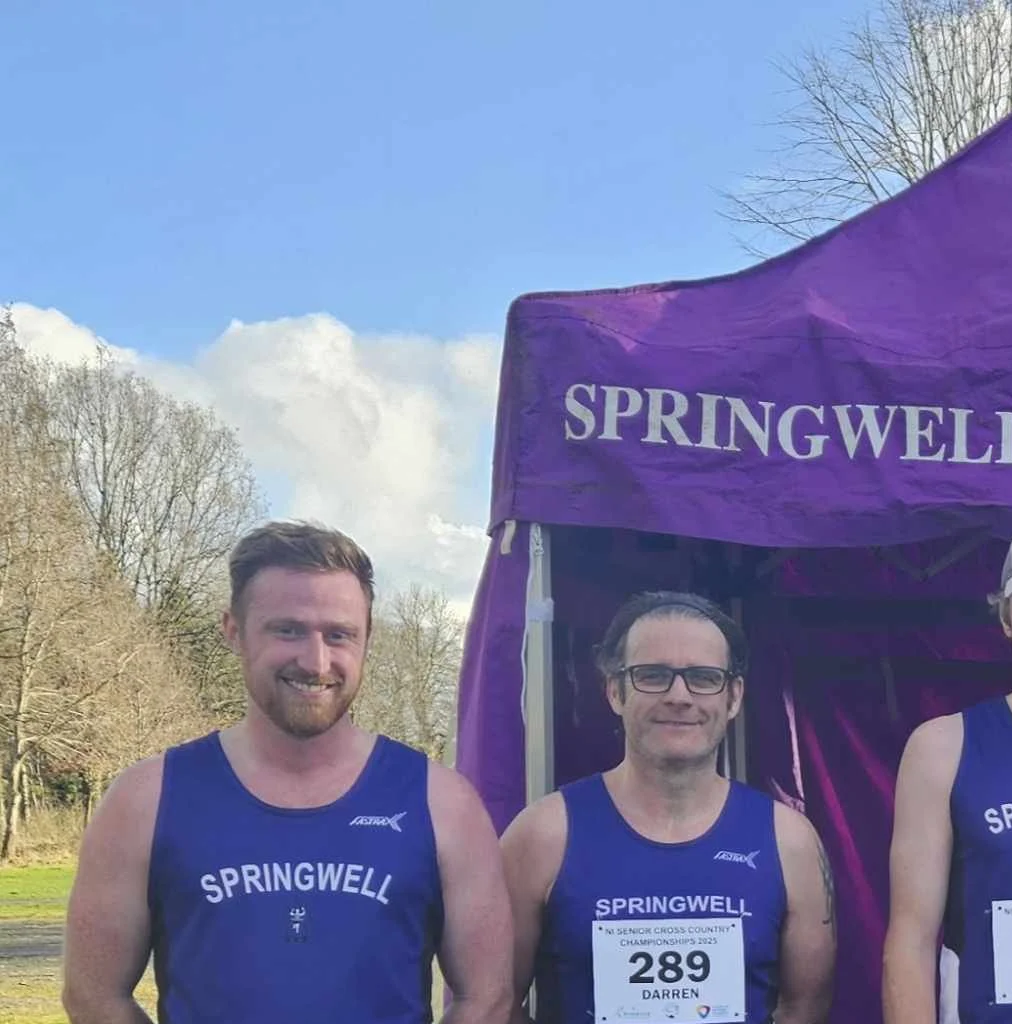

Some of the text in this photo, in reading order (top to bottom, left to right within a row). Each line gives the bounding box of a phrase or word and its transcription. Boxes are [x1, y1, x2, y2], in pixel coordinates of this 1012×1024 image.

[200, 862, 392, 904] SPRINGWELL
[595, 895, 752, 916] SPRINGWELL
[620, 937, 718, 946] CHAMPIONSHIPS 2025
[629, 950, 710, 984] 289
[642, 988, 700, 1000] DARREN
